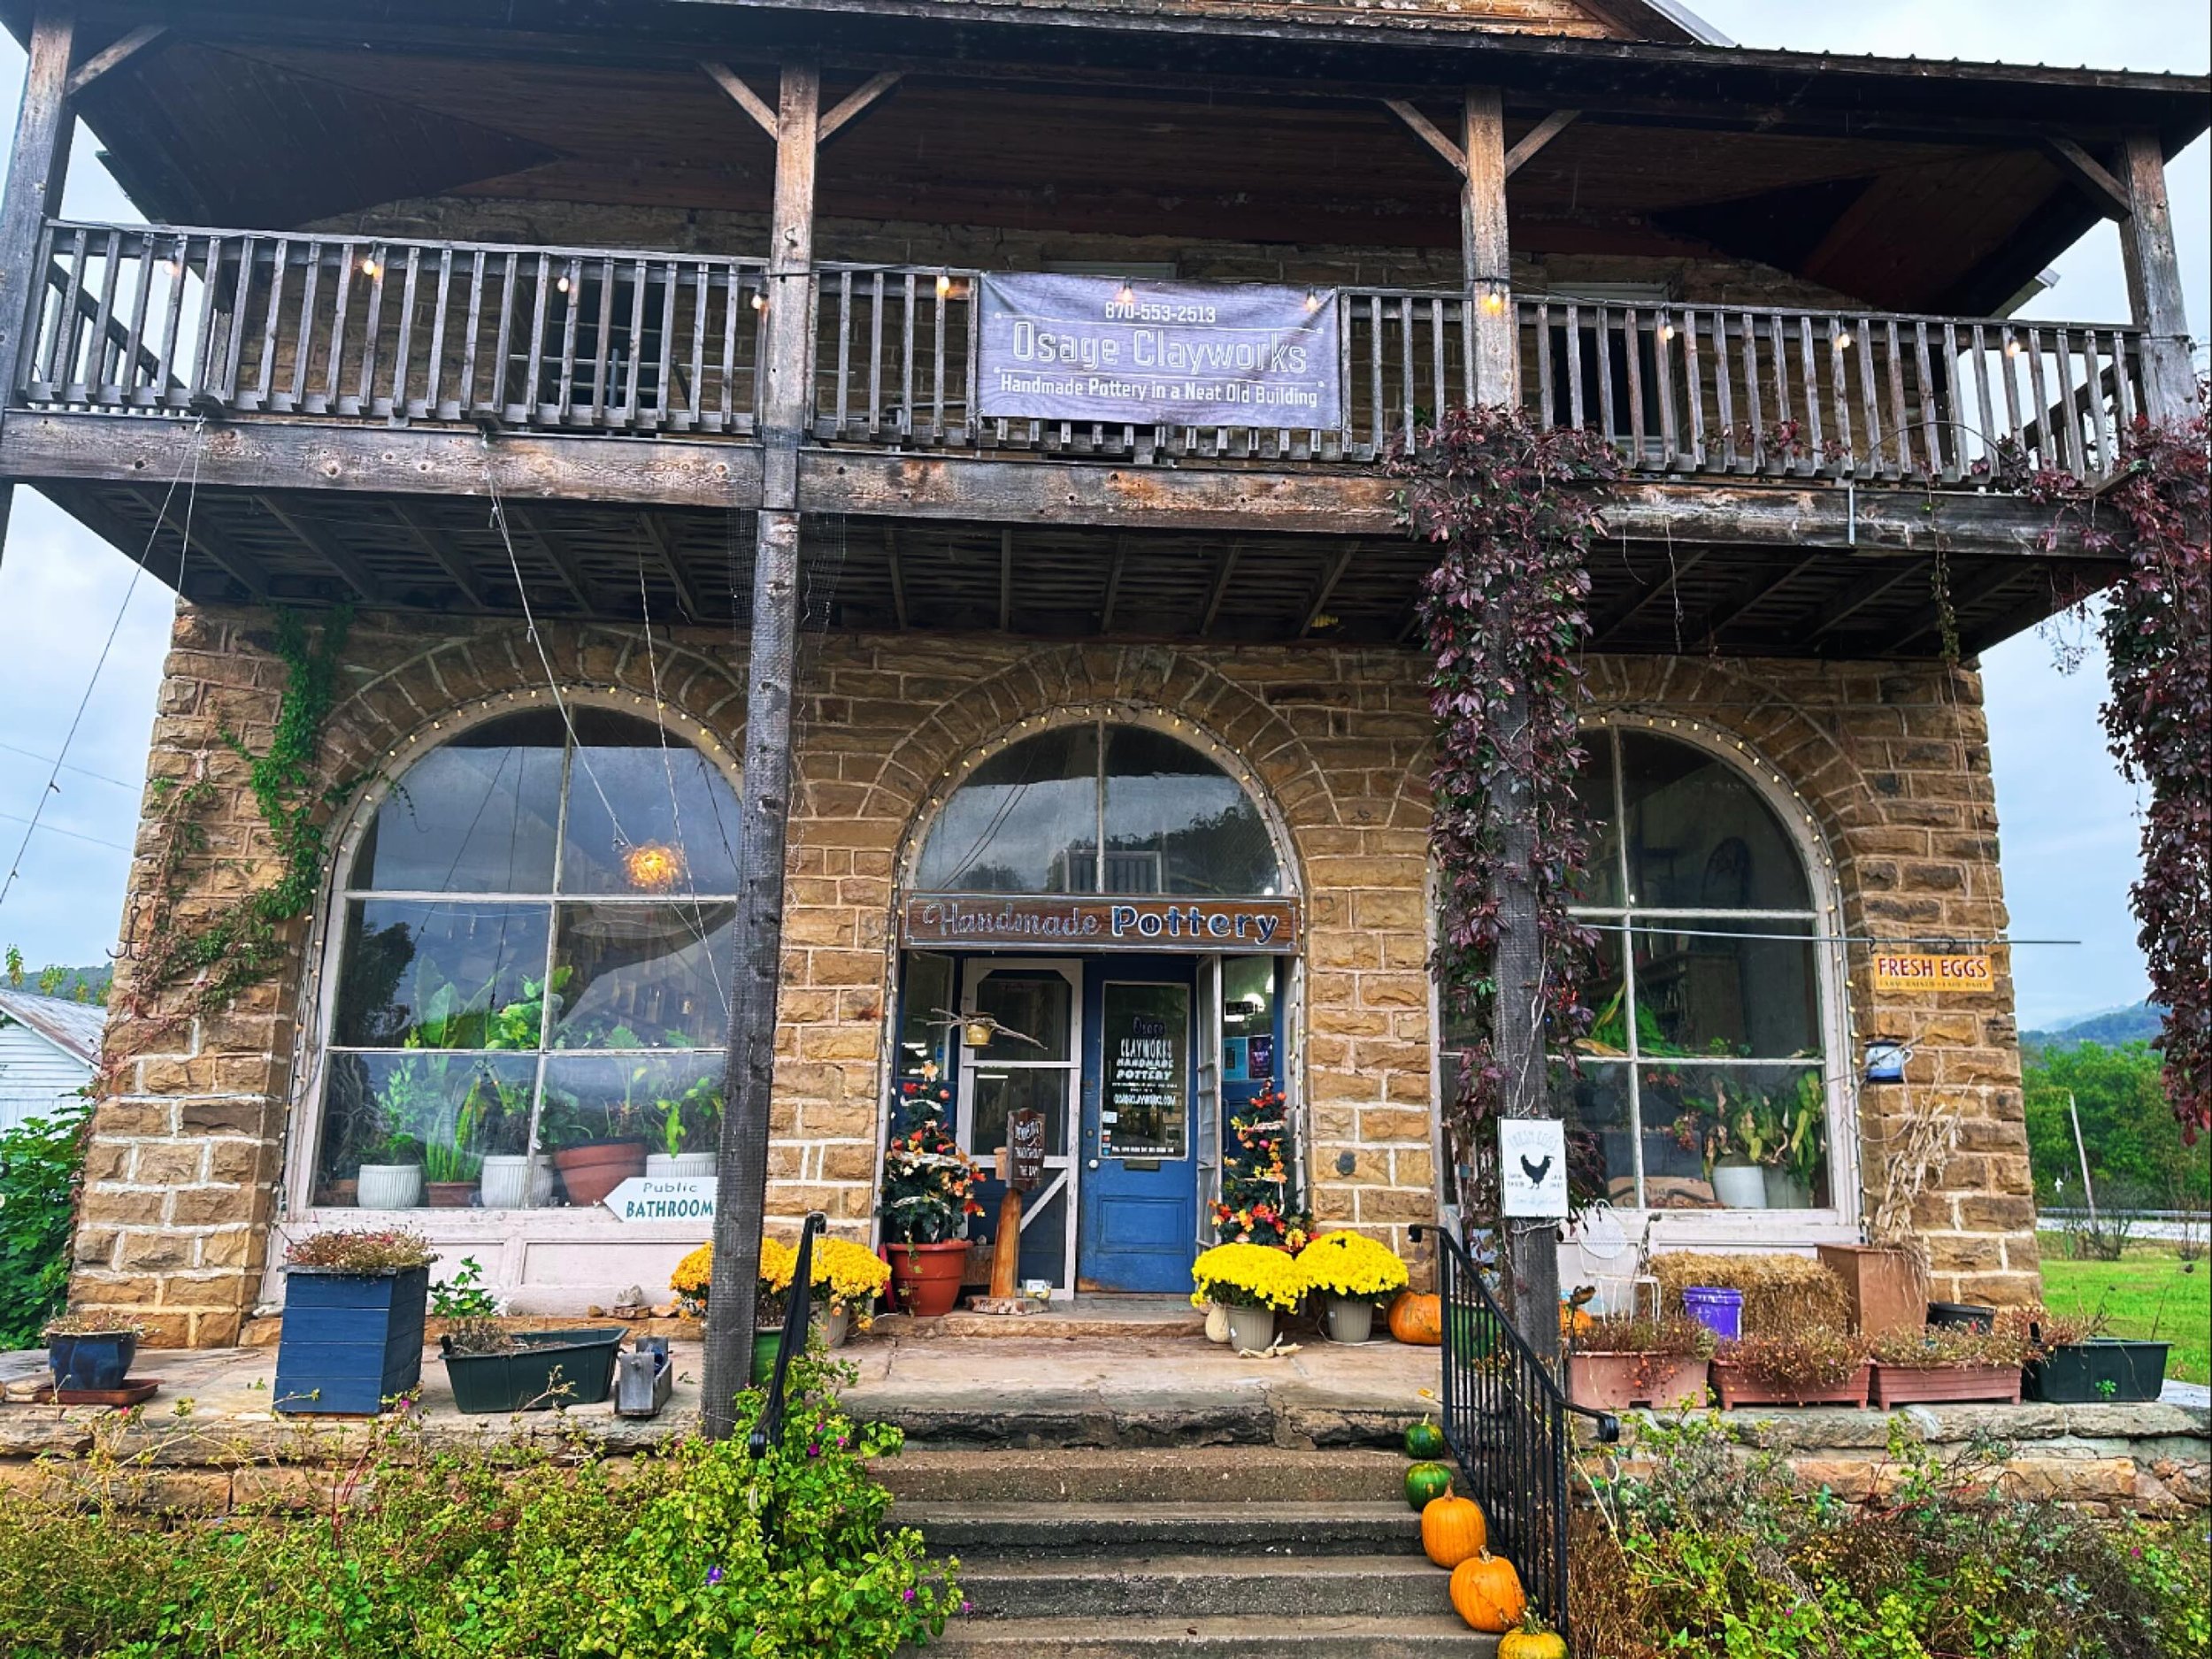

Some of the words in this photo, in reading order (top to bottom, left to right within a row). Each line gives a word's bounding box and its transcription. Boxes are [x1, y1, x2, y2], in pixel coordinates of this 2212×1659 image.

[1106, 302, 1216, 323] 870-553-2513
[1012, 321, 1120, 369] Osage
[1133, 329, 1307, 374] Clayworks
[1001, 373, 1084, 396] Handmade
[1088, 377, 1146, 400] Pottery
[1152, 379, 1165, 398] in
[1171, 385, 1180, 399] a
[1185, 381, 1221, 402] Neat
[1226, 382, 1250, 403] Old
[1256, 385, 1317, 407] Building
[923, 902, 1102, 937] Handmade
[1111, 905, 1279, 945] Pottery
[1878, 957, 1934, 978] FRESH
[1940, 958, 1988, 979] EGGS
[1117, 1070, 1172, 1080] POTTERY
[643, 1182, 698, 1193] Public
[626, 1199, 713, 1217] BATHROOM
